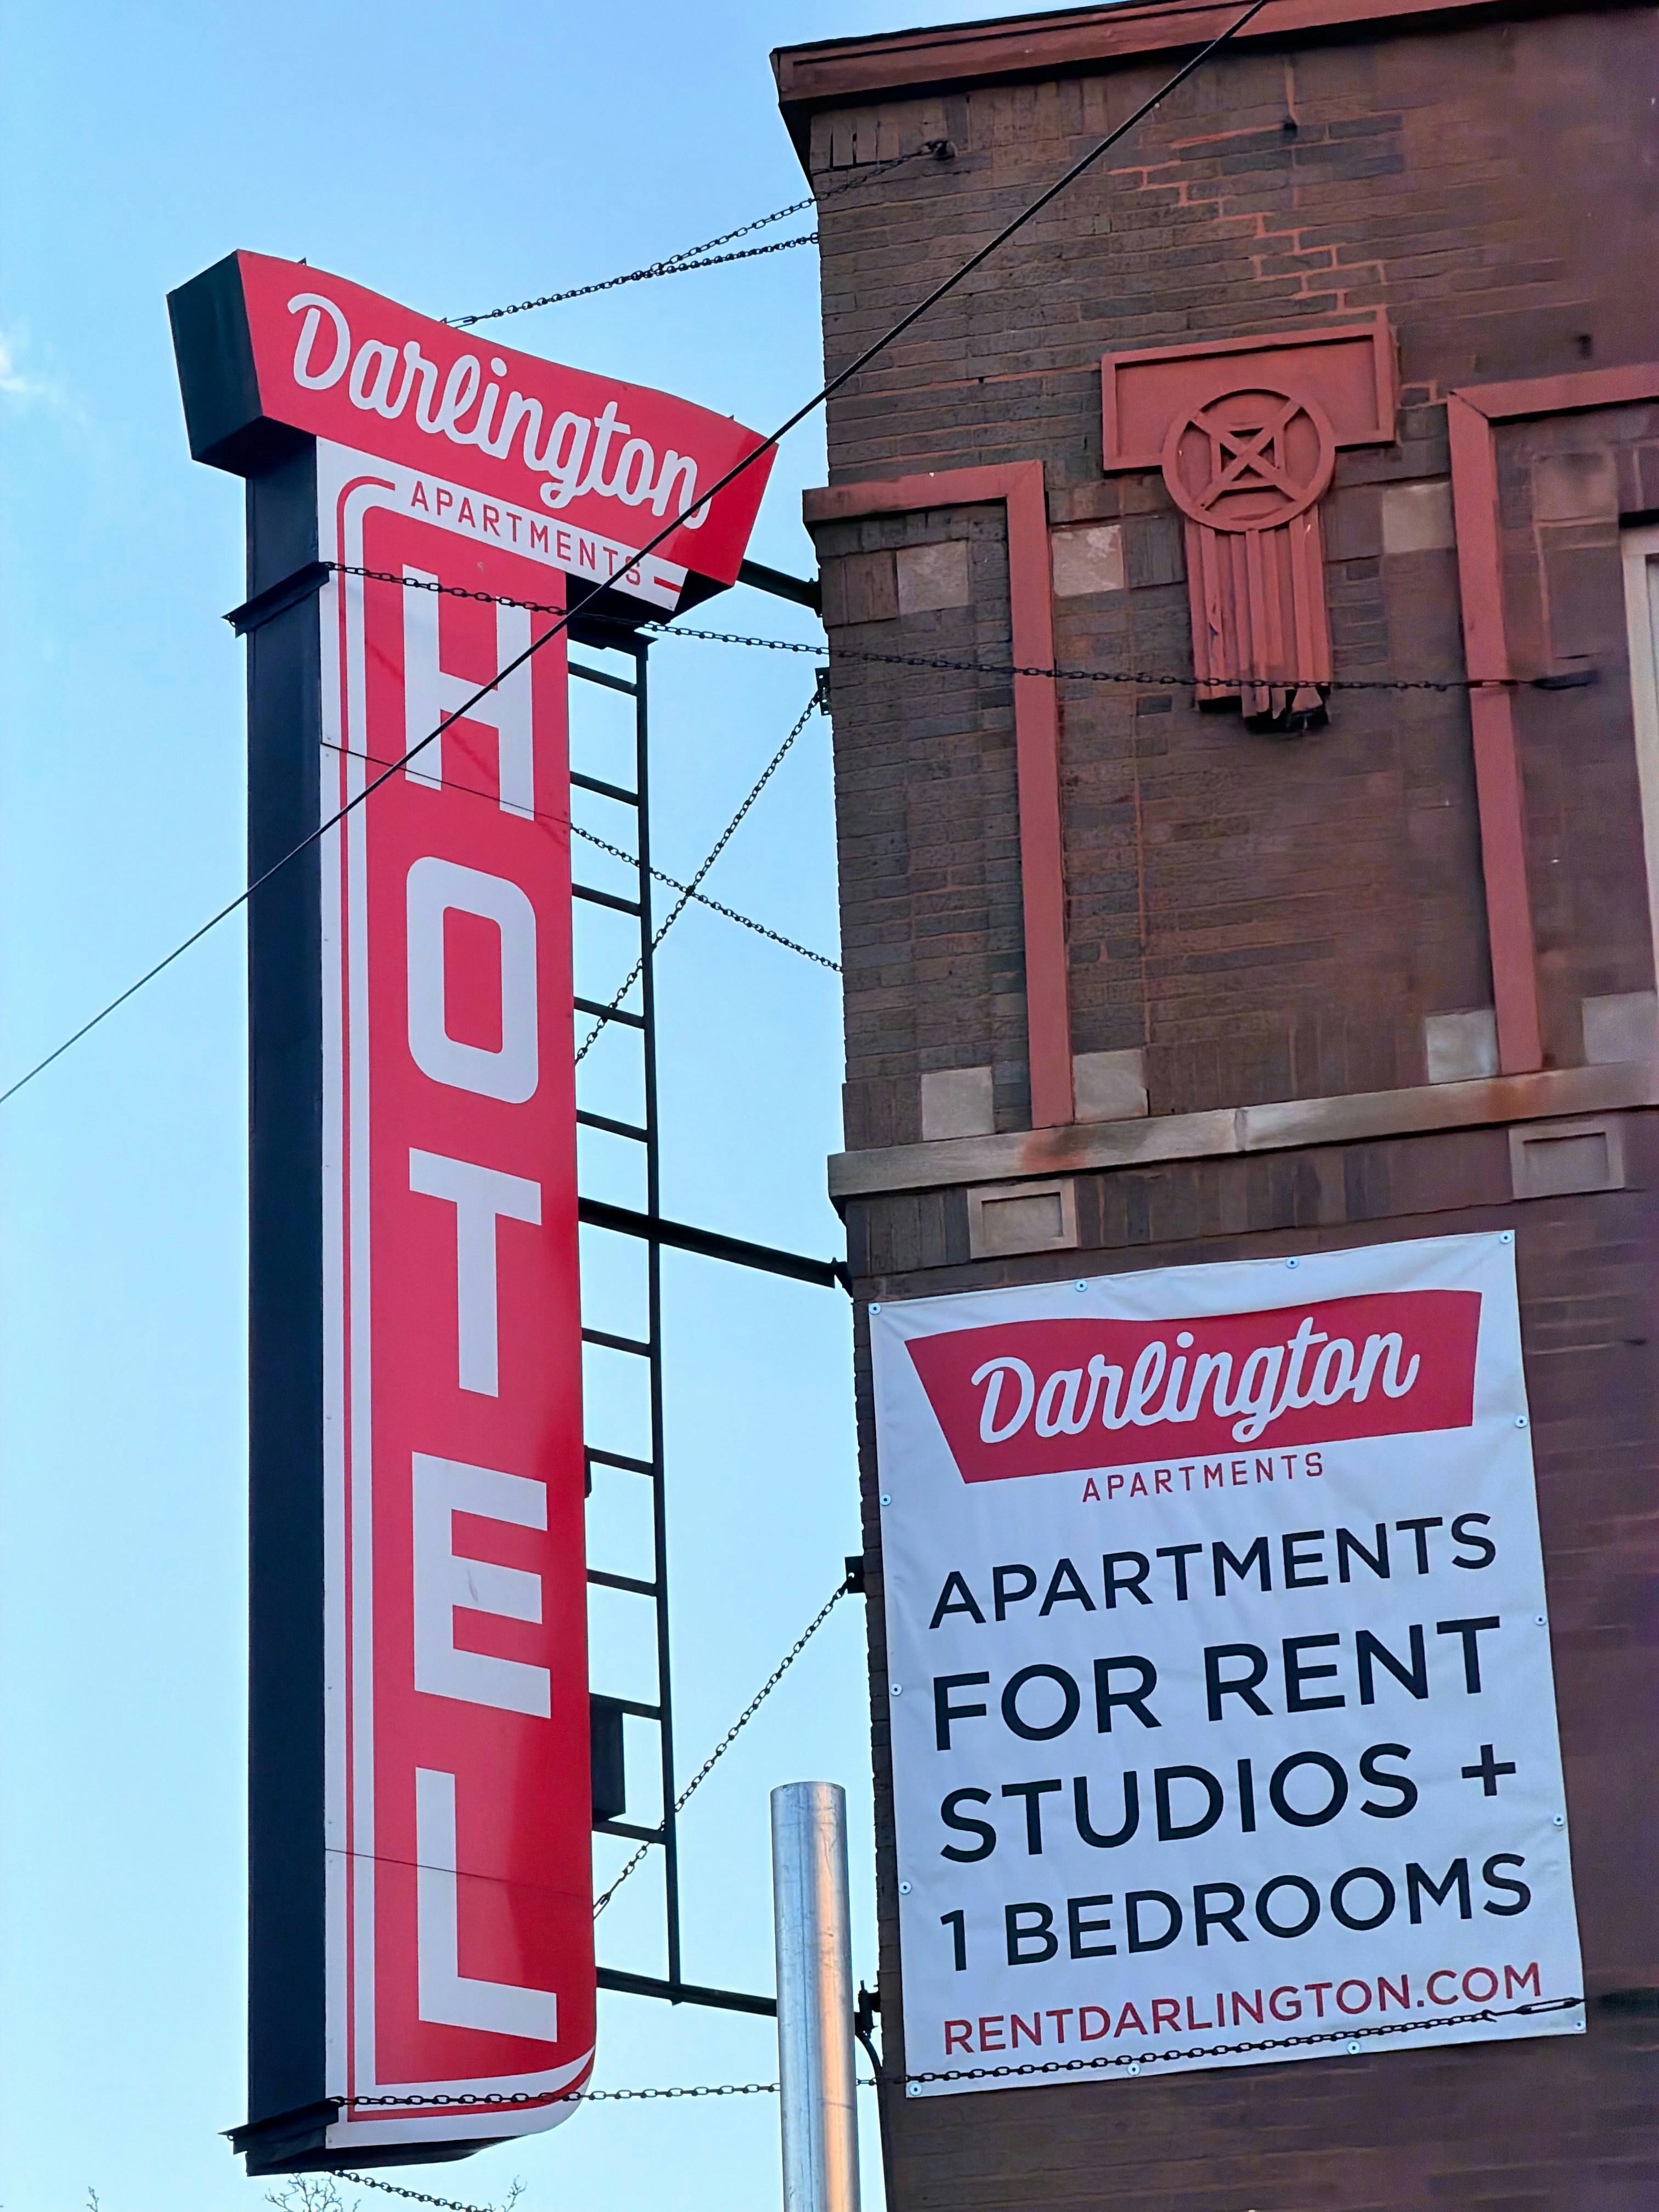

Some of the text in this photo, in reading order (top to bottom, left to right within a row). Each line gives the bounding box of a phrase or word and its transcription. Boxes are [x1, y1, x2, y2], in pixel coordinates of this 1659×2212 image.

[287, 292, 710, 529] Darlington
[411, 481, 641, 585] APARTMENTS
[400, 565, 558, 2043] HOTEL
[971, 1317, 1419, 1443] Darlington
[1082, 1452, 1324, 1503] APARTMENTS
[929, 1513, 1497, 1630] APARTMENTS
[933, 1616, 1500, 1751] FOR RENT
[939, 1743, 1516, 1863] STUDIOS +
[940, 1853, 1532, 1971] 1 BEDROOMS
[944, 1962, 1542, 2055] RENTDARLINGTON.COM
